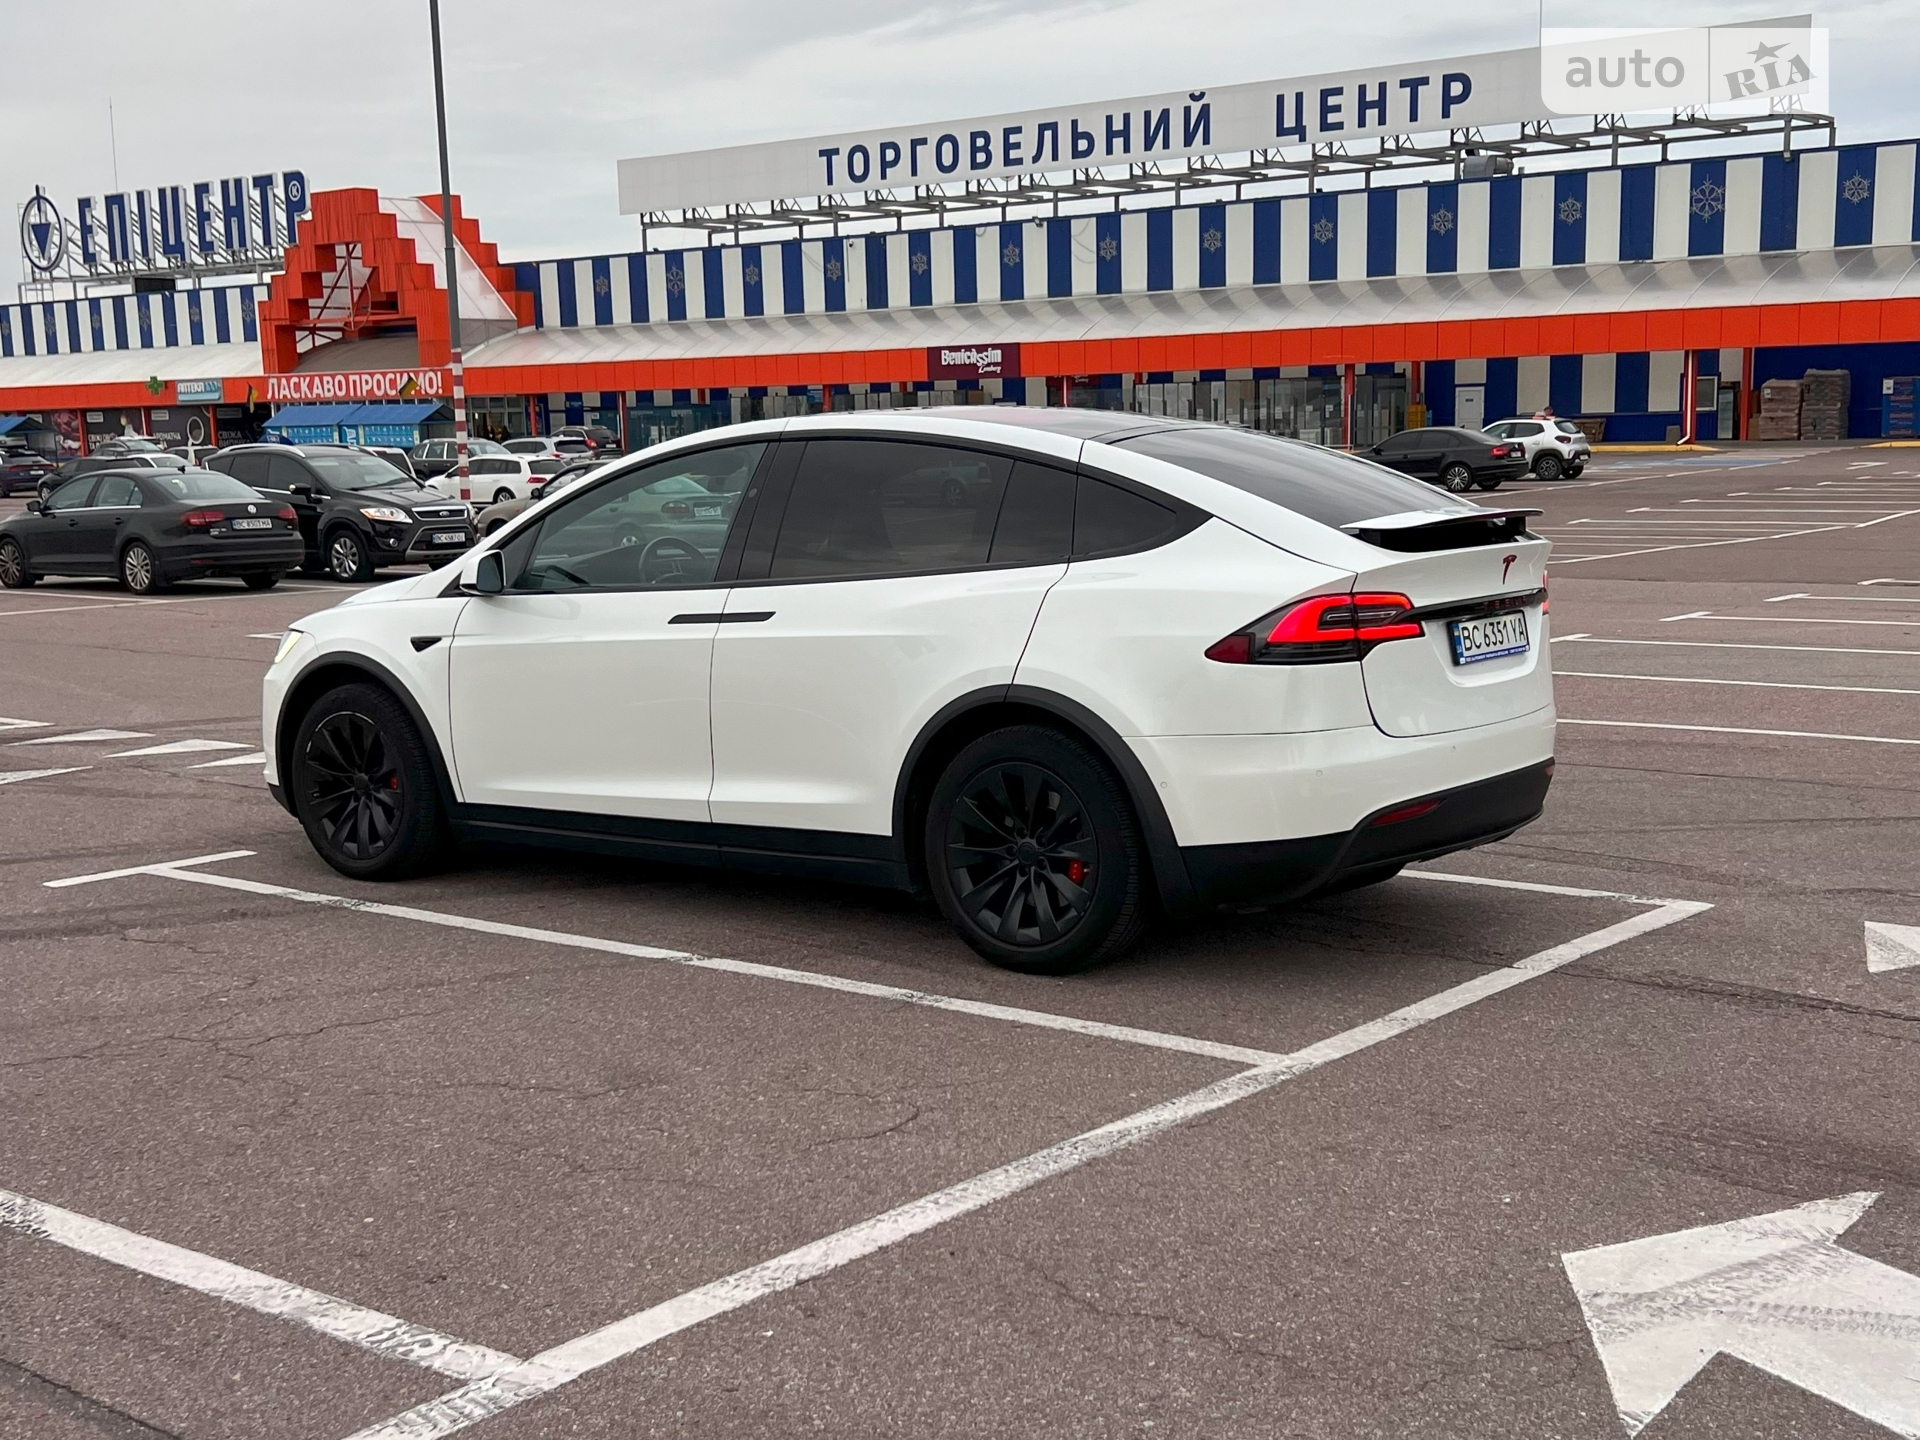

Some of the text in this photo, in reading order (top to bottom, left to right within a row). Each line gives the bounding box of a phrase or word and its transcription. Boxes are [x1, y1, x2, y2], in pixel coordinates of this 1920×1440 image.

[818, 73, 1472, 187] ТОРГОВЕЛЬНИЙ ЦЕНТР
[77, 170, 310, 265] ЕПІЦЕНТР
[178, 382, 205, 393] АПТЕКА
[267, 371, 443, 400] ЛАСКАВО ПРОСИМО!
[1461, 618, 1526, 652] BC 6351 YA
